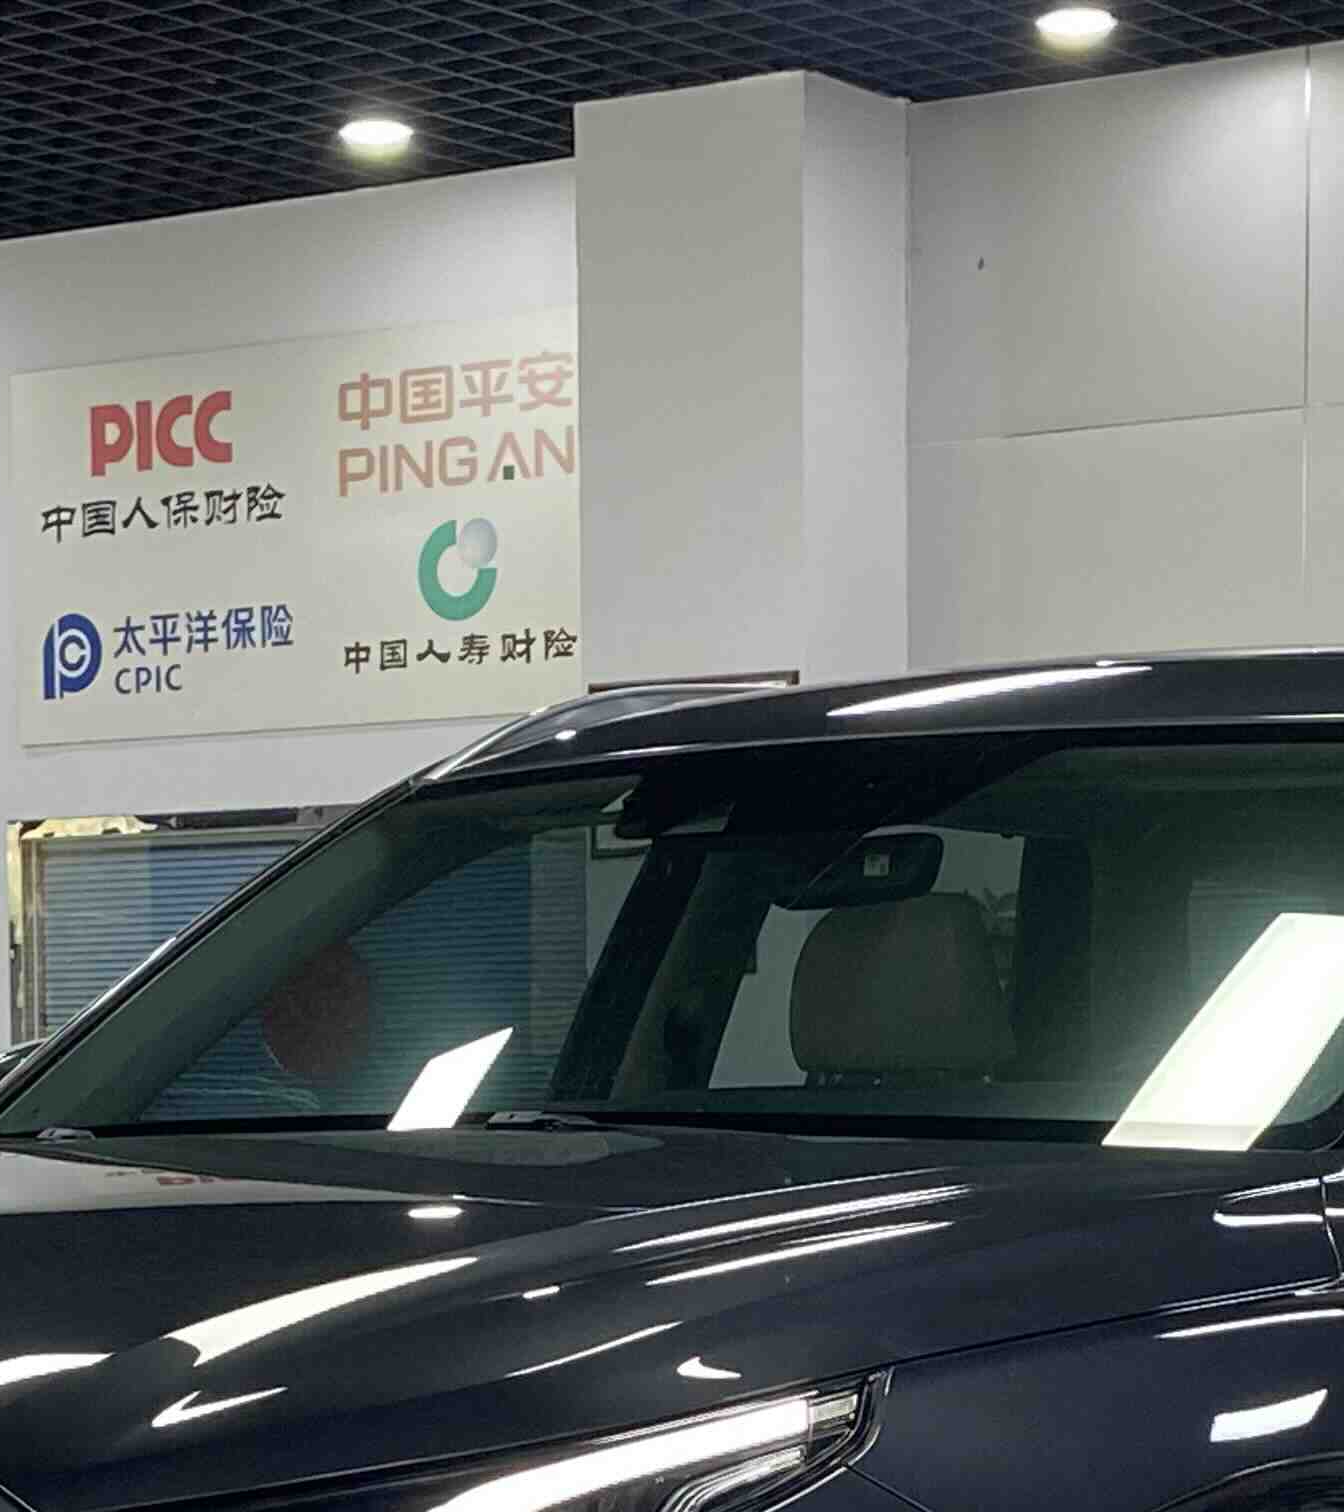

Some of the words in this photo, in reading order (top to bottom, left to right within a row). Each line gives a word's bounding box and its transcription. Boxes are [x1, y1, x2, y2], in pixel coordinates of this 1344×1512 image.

[336, 351, 574, 431] 中国平安
[88, 390, 233, 478] PICC
[40, 483, 287, 544] 中国人保财险
[113, 603, 294, 659] 太平洋保险
[343, 627, 578, 675] 中国人寿财险
[114, 664, 183, 695] CPIC
